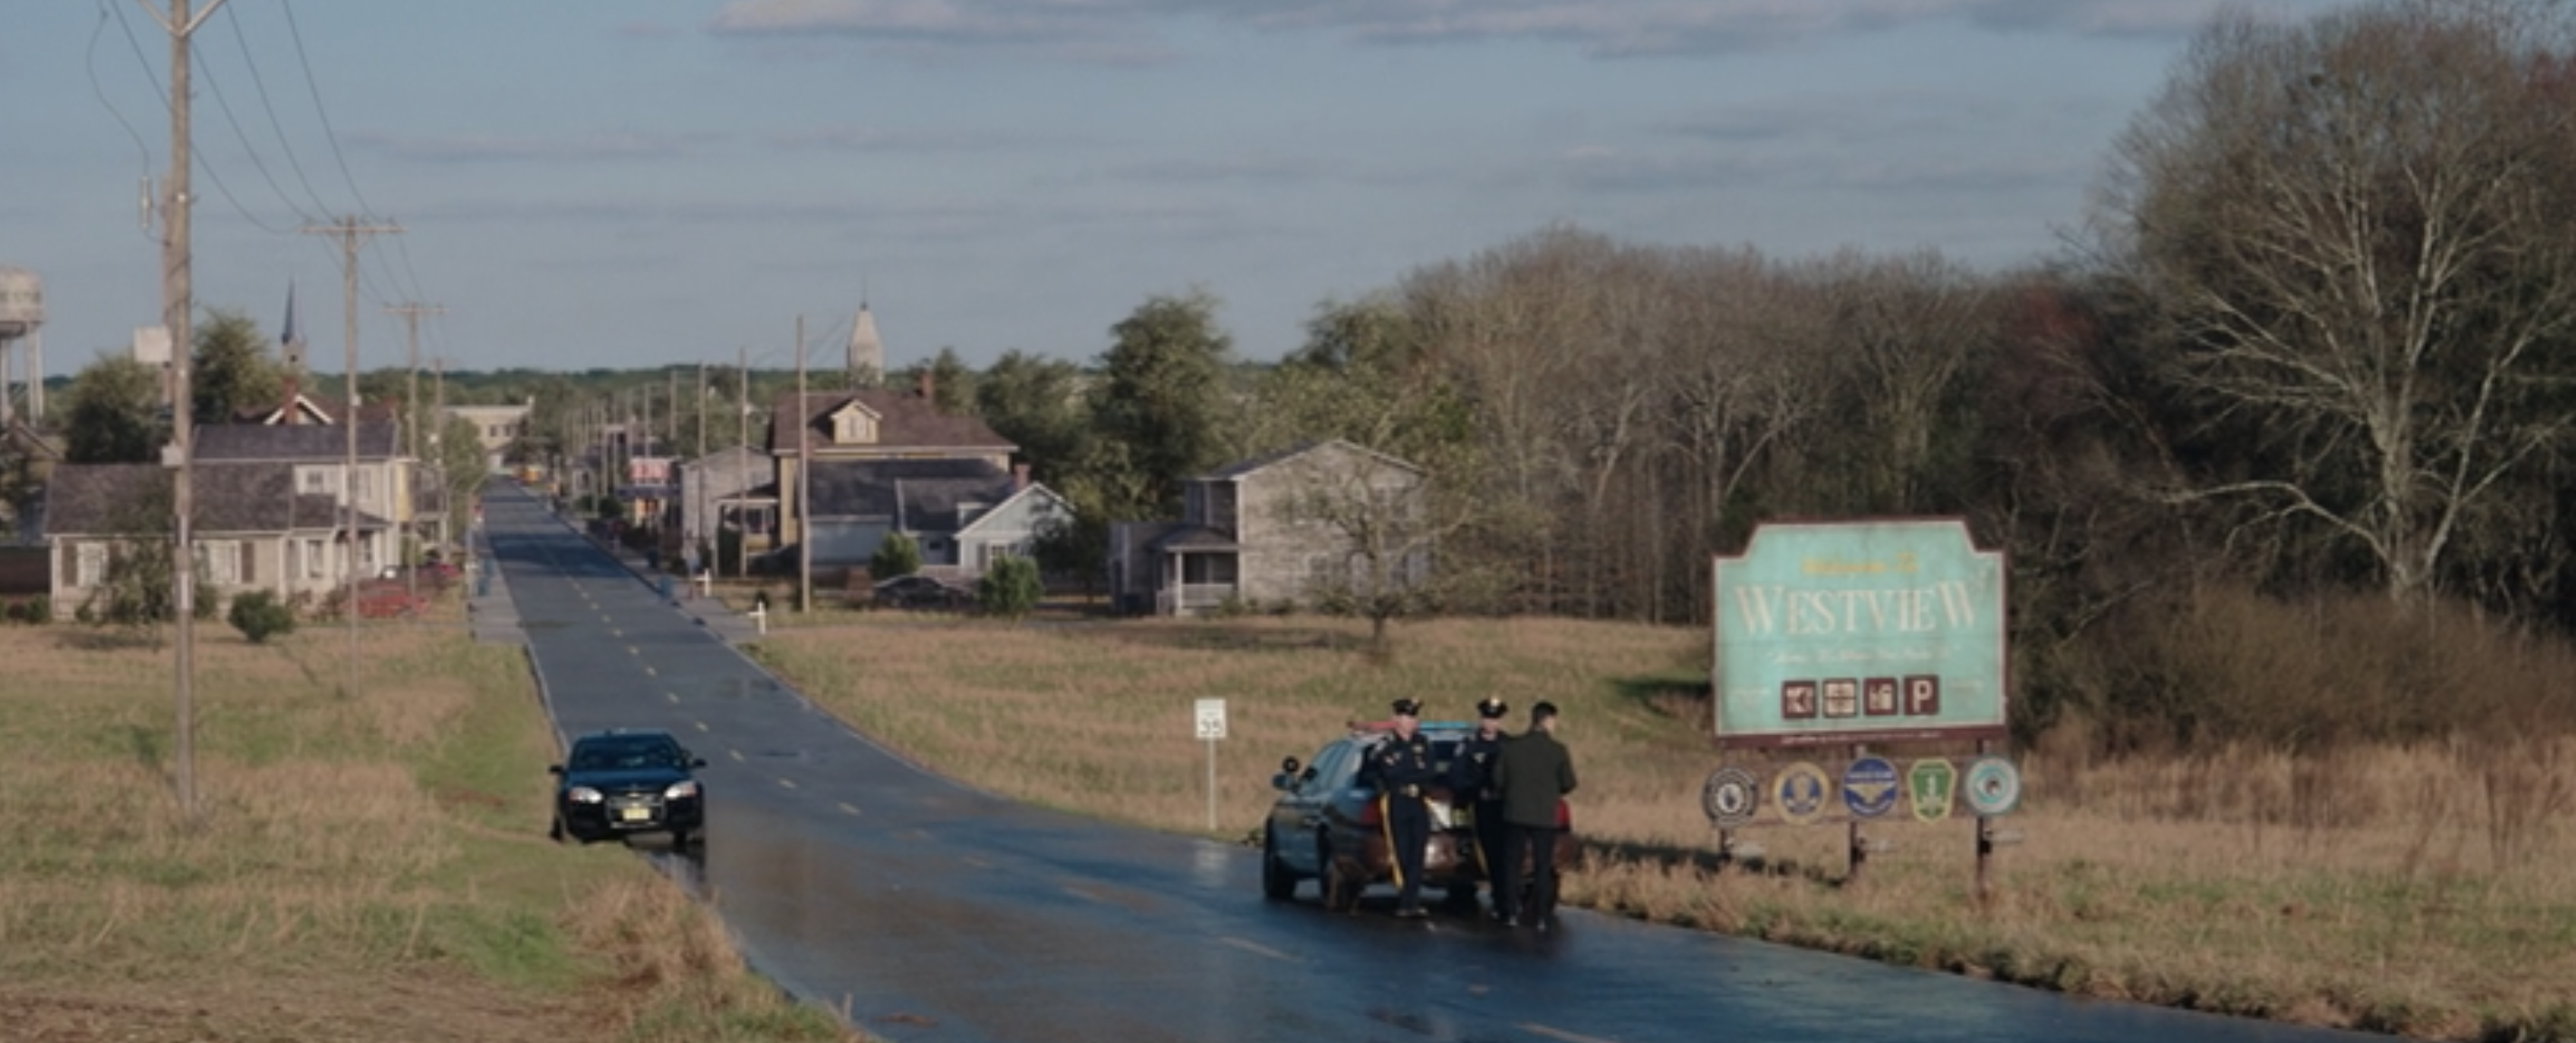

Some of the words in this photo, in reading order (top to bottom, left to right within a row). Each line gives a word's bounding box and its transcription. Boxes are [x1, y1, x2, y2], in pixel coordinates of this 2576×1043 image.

[1735, 582, 1975, 635] WESTVIEW
[1913, 680, 1933, 712] P
[1200, 717, 1224, 735] 35
